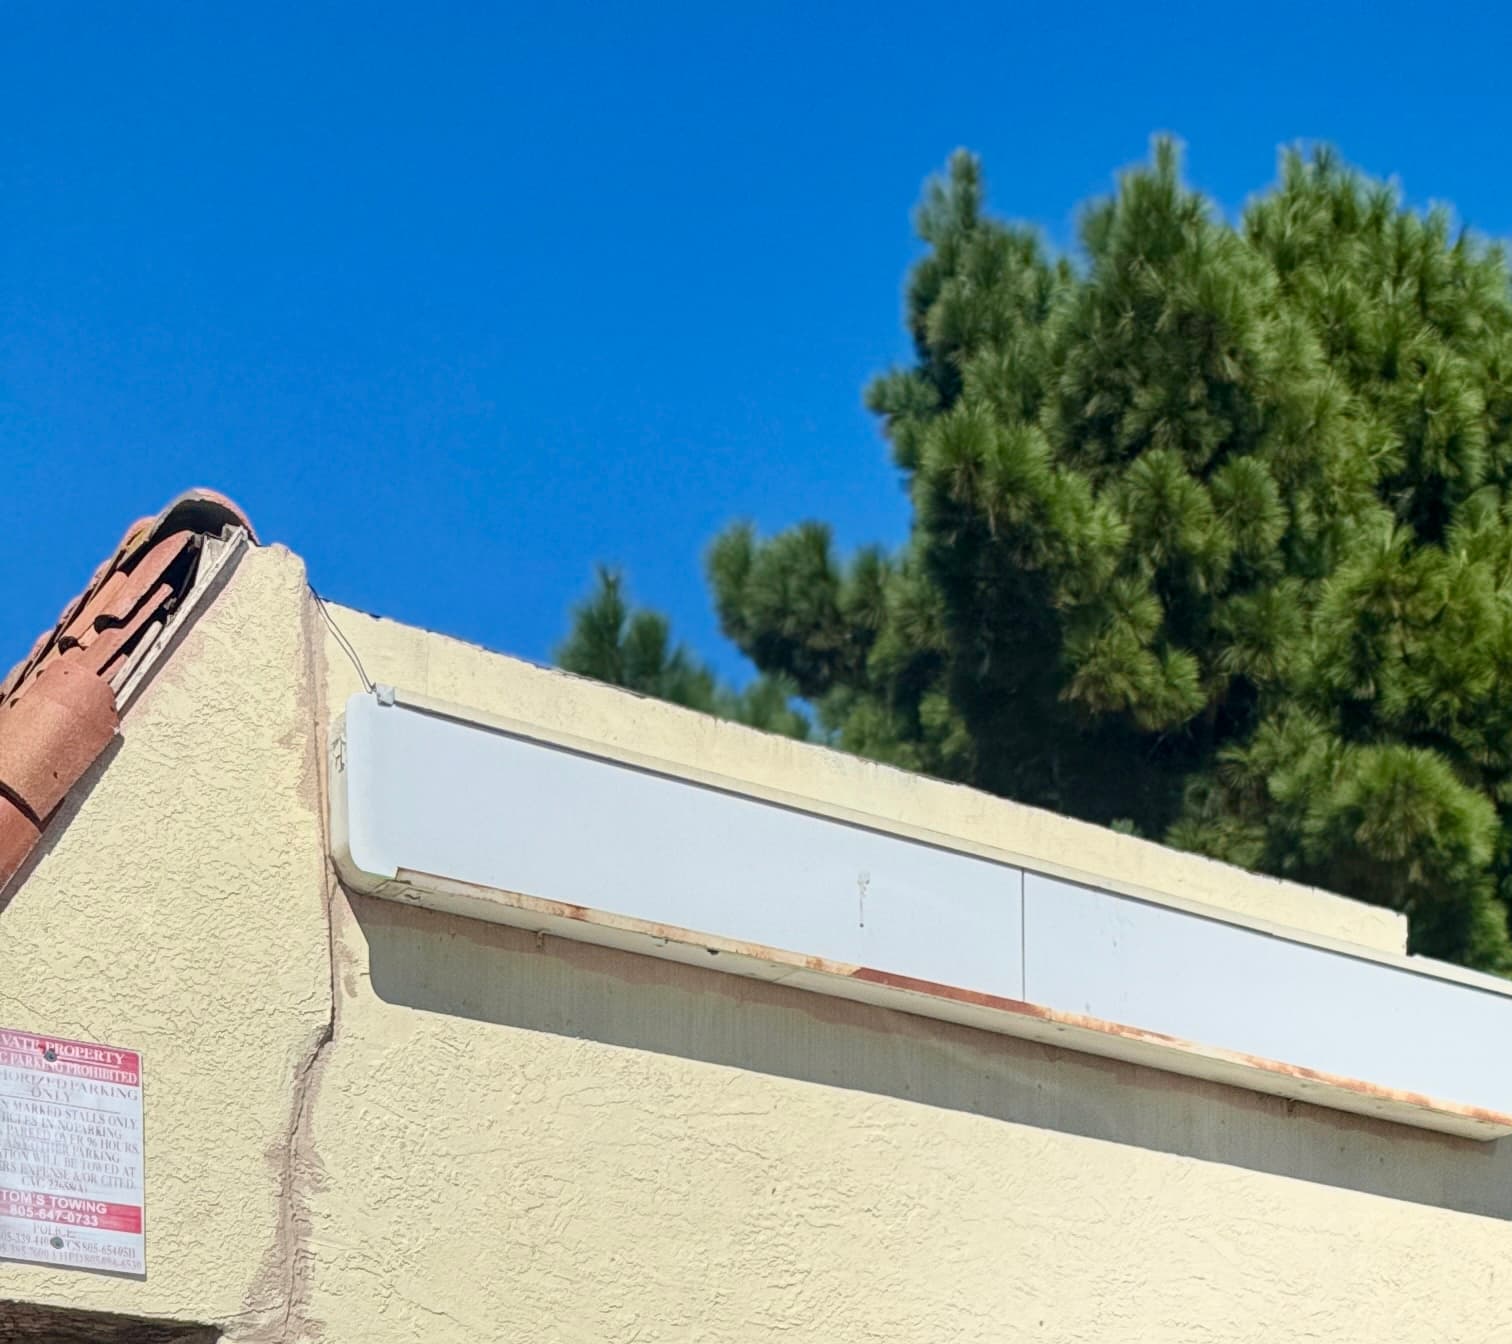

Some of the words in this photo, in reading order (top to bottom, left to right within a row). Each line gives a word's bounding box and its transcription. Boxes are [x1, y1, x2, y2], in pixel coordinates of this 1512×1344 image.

[46, 1041, 125, 1065] PROPERTY
[32, 1087, 71, 1102] ONLY
[108, 1117, 137, 1130] ONLY
[123, 1167, 136, 1177] AT
[1, 1189, 45, 1206] TOM'S
[48, 1196, 108, 1215] TOWING
[9, 1204, 99, 1227] 805-647-0733
